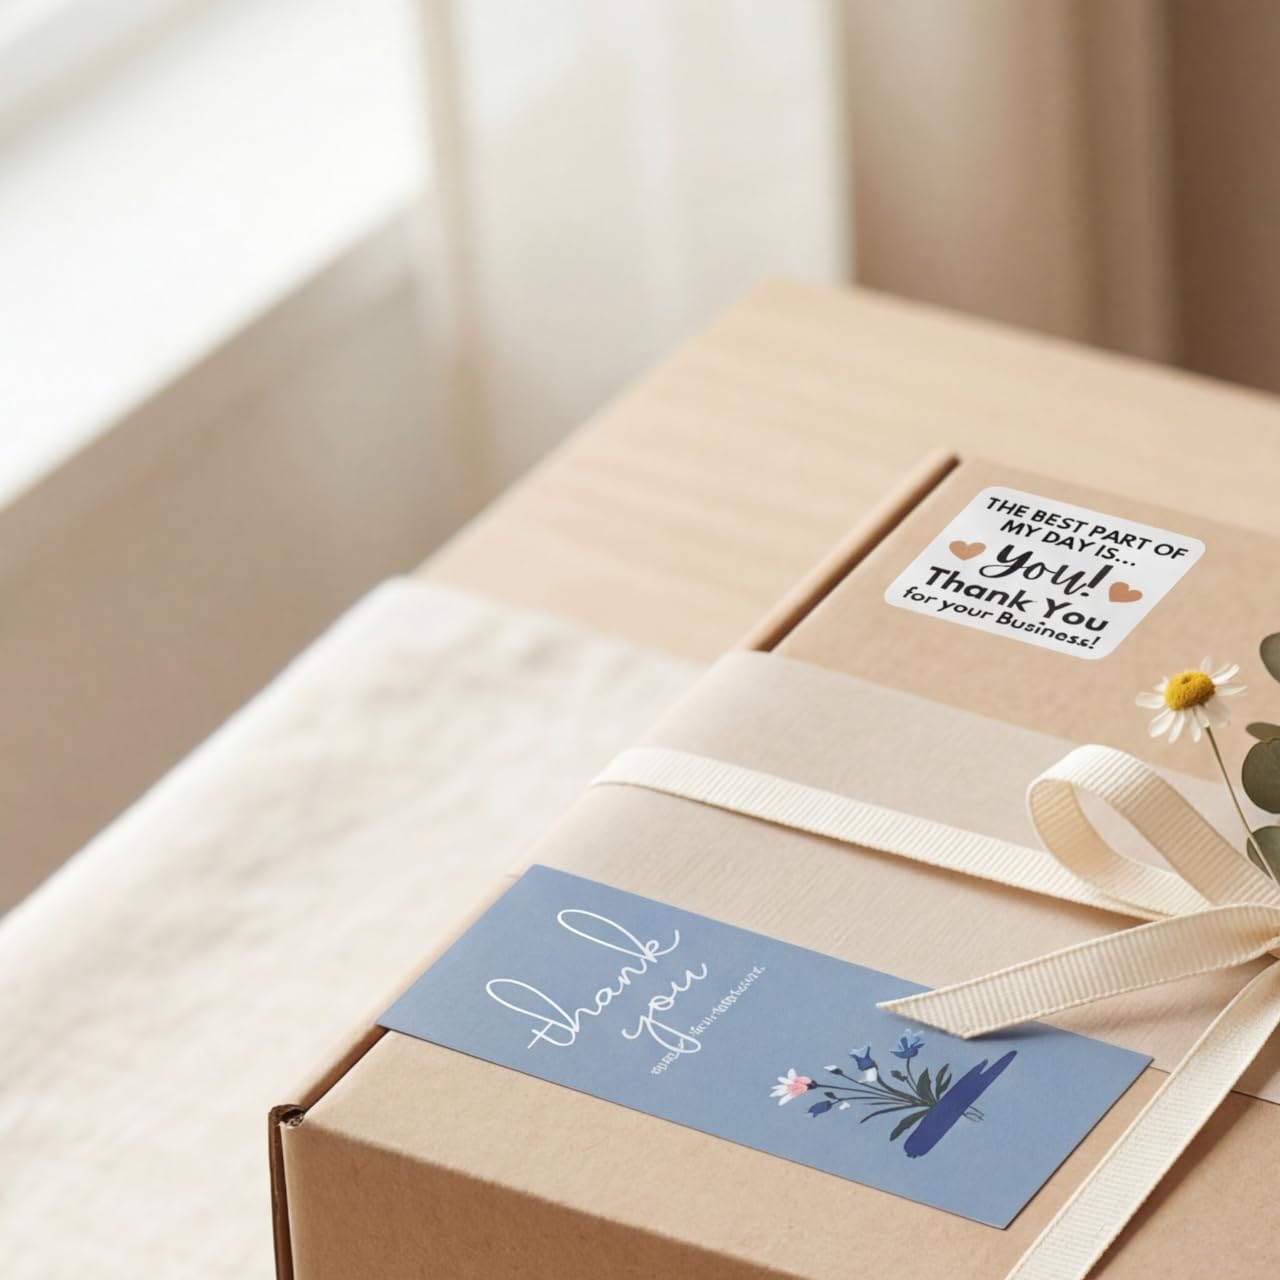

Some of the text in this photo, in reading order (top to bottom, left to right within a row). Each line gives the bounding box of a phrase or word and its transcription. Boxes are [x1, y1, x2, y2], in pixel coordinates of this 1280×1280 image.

[986, 497, 1190, 560] THE BEST PART OF
[1000, 519, 1136, 566] MY DAY IS...
[902, 586, 1101, 650] for your Business!
[925, 566, 1110, 632] Thank You
[486, 908, 680, 1050] thank
[621, 962, 708, 1054] you
